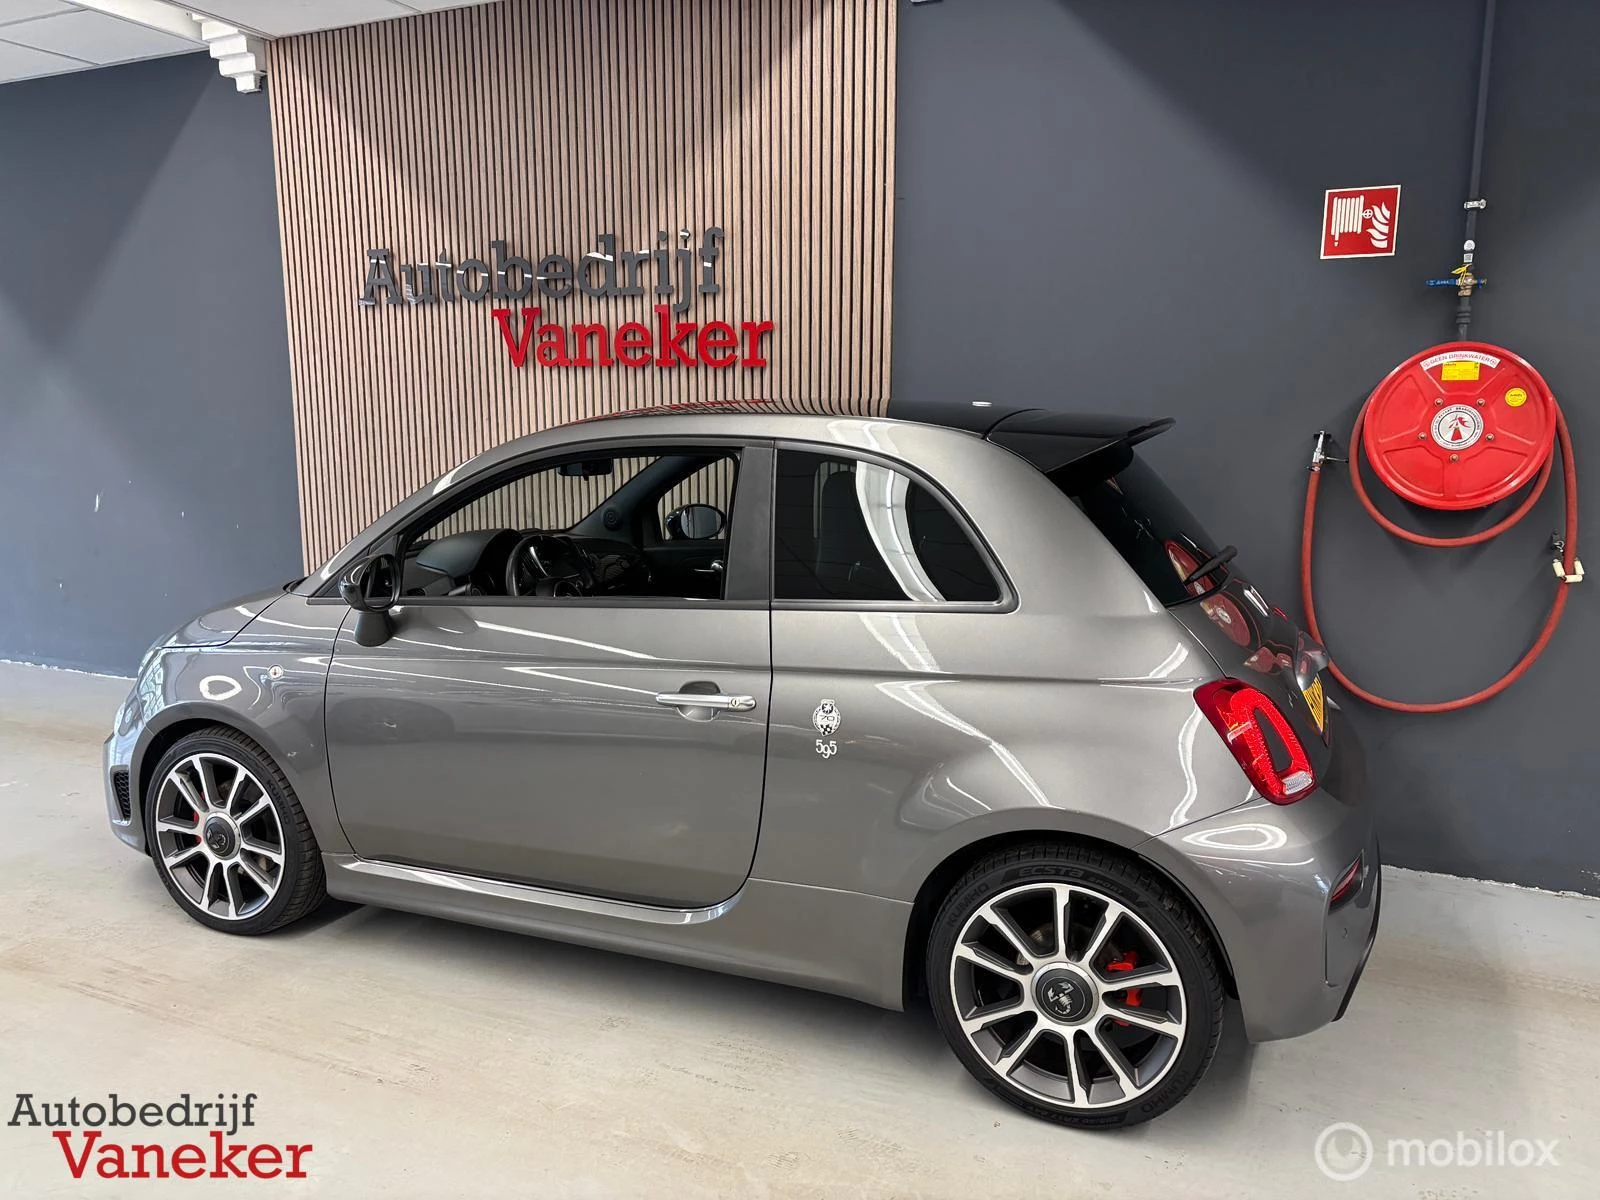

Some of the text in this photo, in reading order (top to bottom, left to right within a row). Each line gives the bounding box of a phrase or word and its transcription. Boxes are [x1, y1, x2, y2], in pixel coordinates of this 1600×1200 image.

[359, 226, 725, 313] Autobedrijf
[492, 304, 774, 369] Vaneker
[815, 739, 838, 759] 595
